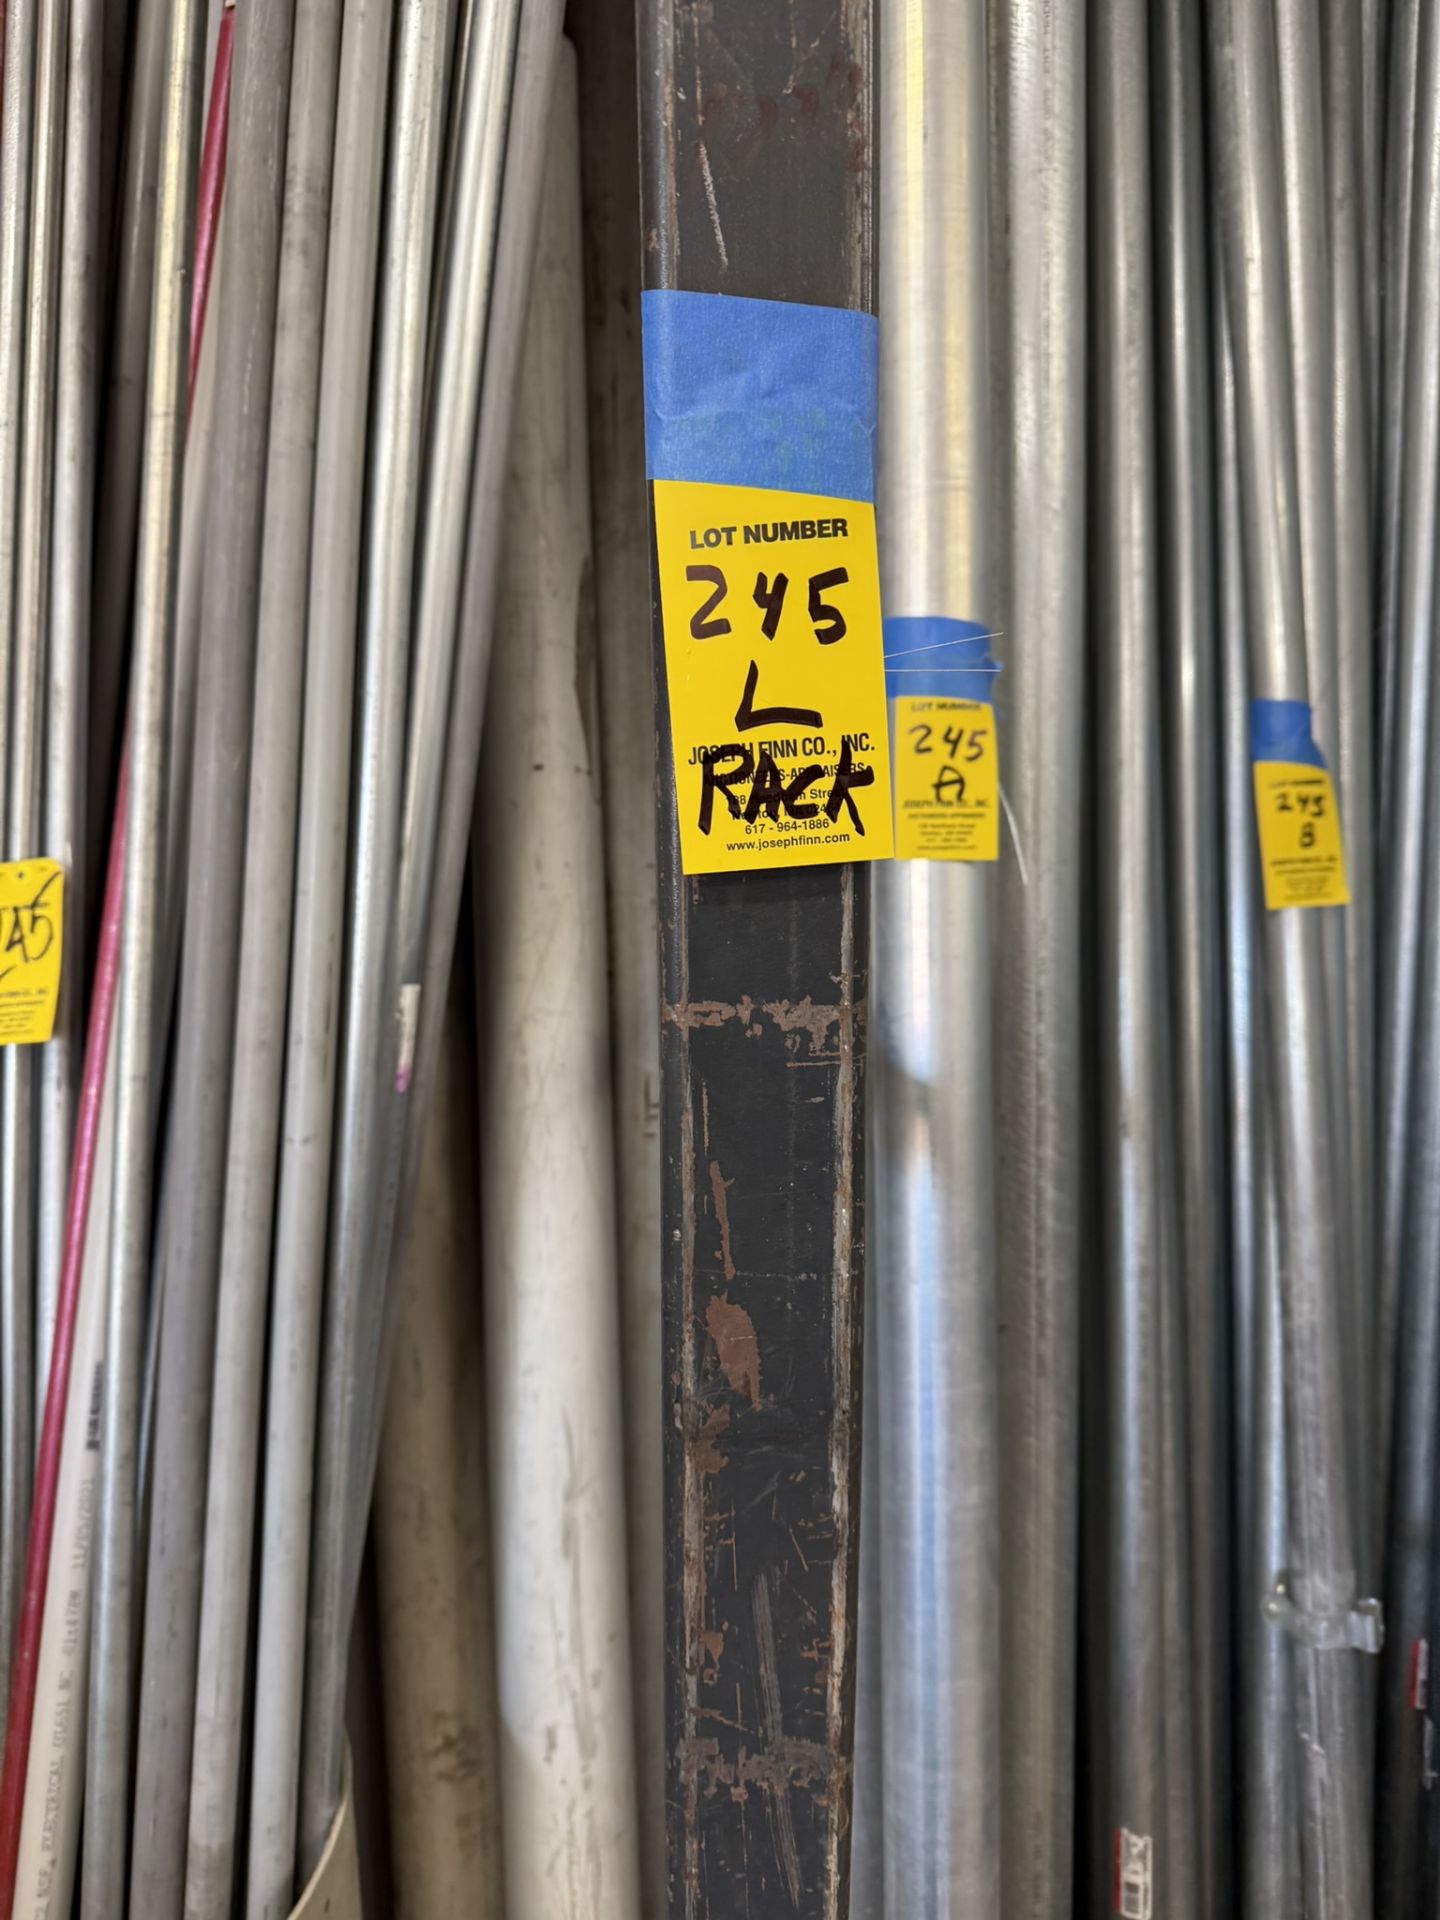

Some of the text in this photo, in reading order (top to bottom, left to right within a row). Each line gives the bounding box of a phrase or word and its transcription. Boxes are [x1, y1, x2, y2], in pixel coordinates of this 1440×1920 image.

[689, 518, 848, 549] LOT NUMBER
[685, 564, 849, 645] 245
[734, 659, 823, 732] L
[758, 738, 798, 760] FINN
[801, 735, 837, 759] CO.,
[908, 723, 988, 762] 245
[697, 735, 875, 836] RACK
[727, 794, 747, 806] 88
[809, 786, 846, 800] Stre
[931, 765, 966, 802] A
[726, 833, 850, 852] www.josephfinn.com
[745, 824, 766, 835] 617
[776, 818, 830, 833] 964-1886
